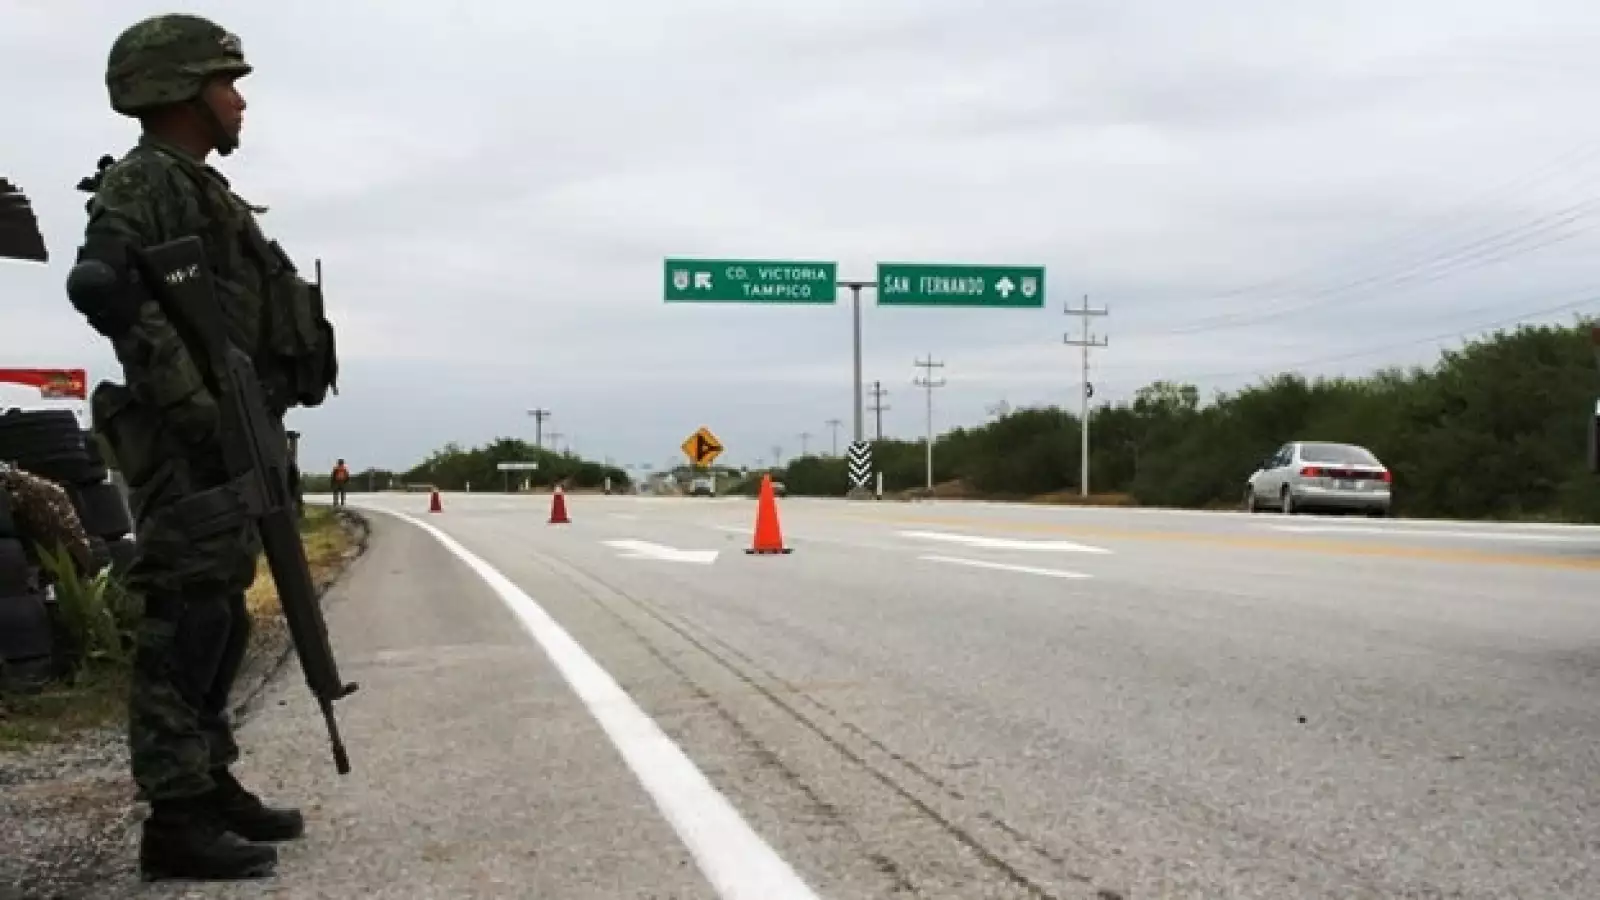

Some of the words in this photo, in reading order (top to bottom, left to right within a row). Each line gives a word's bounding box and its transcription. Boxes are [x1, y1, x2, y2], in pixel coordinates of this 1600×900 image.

[758, 266, 828, 281] VICTORIA
[742, 283, 812, 298] TAMPICO
[884, 274, 911, 294] SAN
[919, 276, 985, 296] FERNANDO
